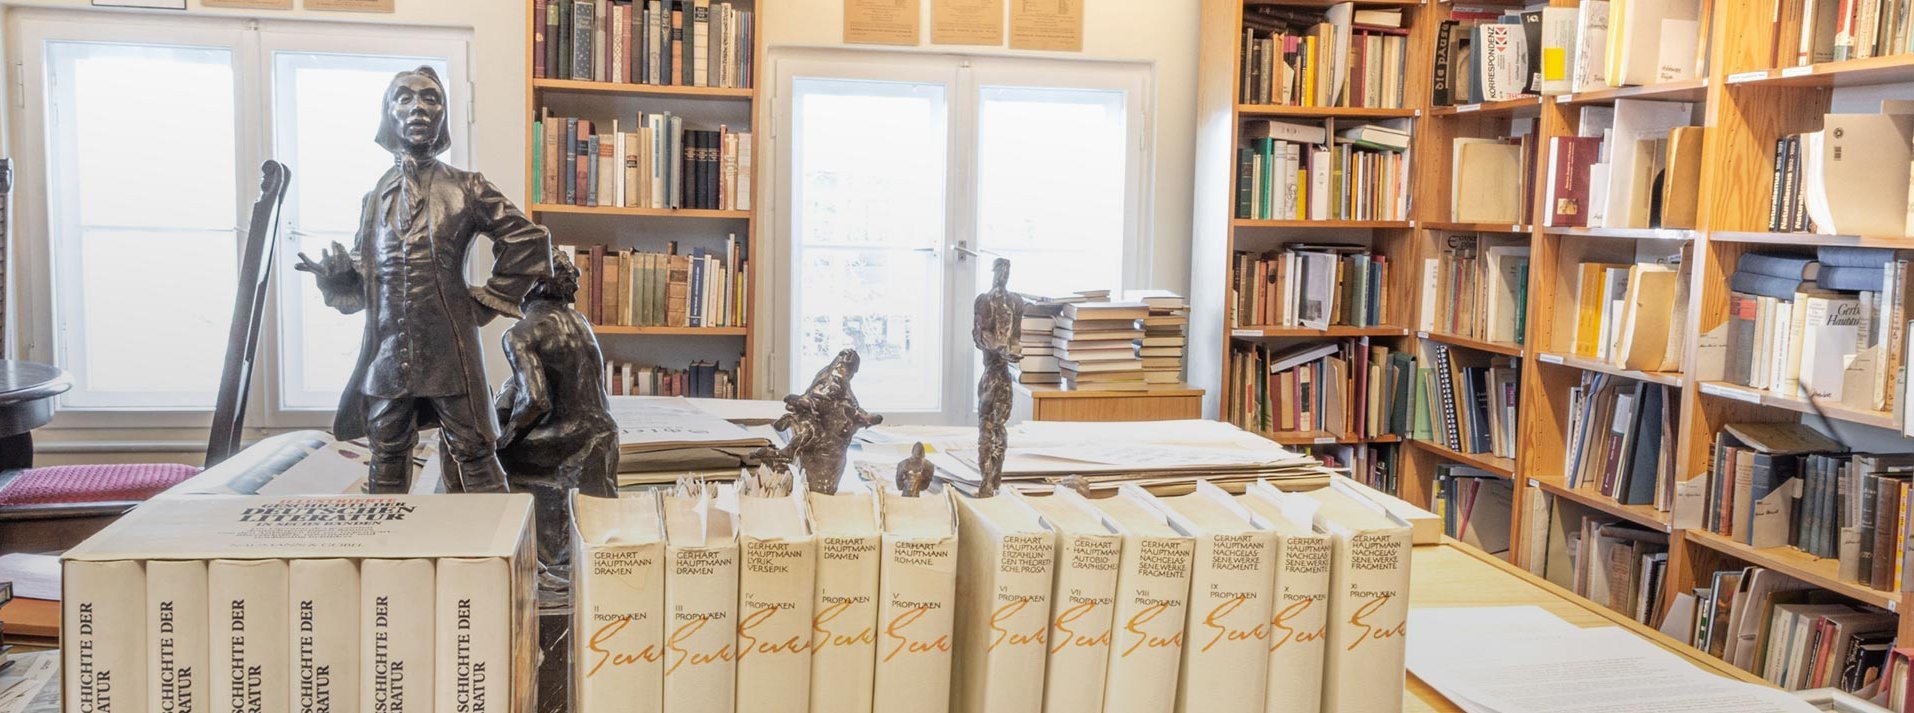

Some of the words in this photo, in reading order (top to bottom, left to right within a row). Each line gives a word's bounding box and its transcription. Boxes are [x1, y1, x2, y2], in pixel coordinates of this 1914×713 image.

[1488, 26, 1497, 98] KORRESPONDENZ
[1769, 171, 1780, 228] Naturalismus
[1780, 172, 1792, 229] Naturalismus
[241, 506, 416, 515] DEUTSCHEN
[239, 514, 405, 522] LITERATUR
[824, 537, 864, 545] GERHART
[1074, 540, 1112, 548] GERHART
[1141, 540, 1180, 548] GERHART
[1287, 537, 1324, 545] GERHART
[1352, 541, 1400, 549] HAUPTMANN
[748, 542, 789, 550] GERHART
[824, 544, 876, 552] HAUPTMANN
[895, 541, 936, 550] GERHART
[594, 551, 638, 559] GERHART
[677, 551, 719, 559] GERHART
[748, 550, 802, 558] HAUPTMANN
[895, 549, 948, 557] HAUPTMANN
[1140, 547, 1190, 556] HAUPTMANN
[824, 552, 859, 560] DRAMEN
[594, 558, 652, 567] HAUPTMANN
[677, 558, 731, 567] HAUPTMANN
[895, 557, 934, 565] ROMANE
[748, 565, 789, 573] VERSEPIK
[1160, 563, 1186, 571] WERKE
[1285, 565, 1328, 573] FRAGMENTE
[1351, 562, 1397, 570] FRAGMENTE
[676, 567, 713, 575] DRAMEN
[1138, 569, 1184, 578] FRAGMENTE
[231, 599, 245, 632] DER
[375, 596, 388, 627] DER
[457, 598, 471, 630] DER
[80, 602, 93, 636] DER
[160, 601, 173, 634] DER
[300, 600, 313, 632] DER
[161, 638, 174, 713] CHICHTE
[375, 632, 388, 713] SCHICHTE
[391, 661, 404, 713] RATUR
[473, 662, 486, 713] RATUR
